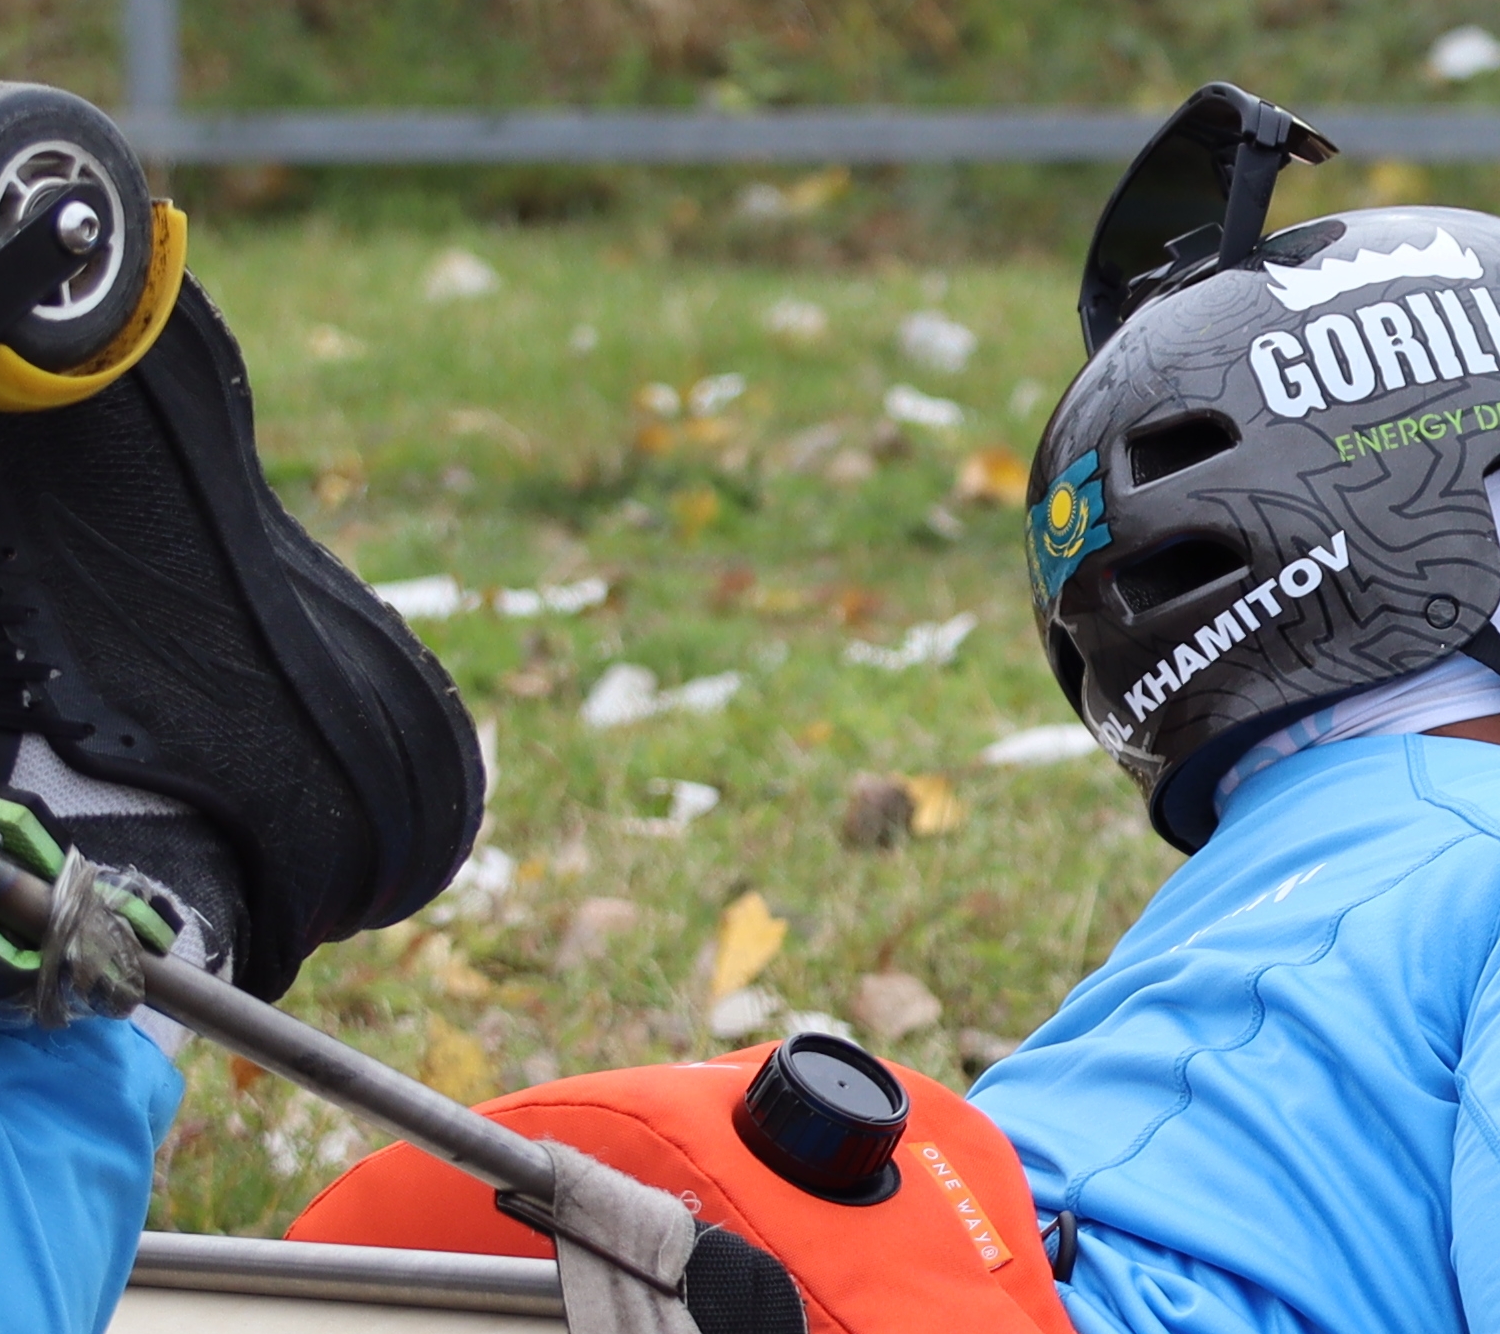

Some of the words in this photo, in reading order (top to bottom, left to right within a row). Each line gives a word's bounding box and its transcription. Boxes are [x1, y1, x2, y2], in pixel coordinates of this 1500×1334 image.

[1334, 407, 1463, 463] ENERGY
[1123, 529, 1350, 723] KHAMITOV
[922, 1147, 961, 1190] ONE
